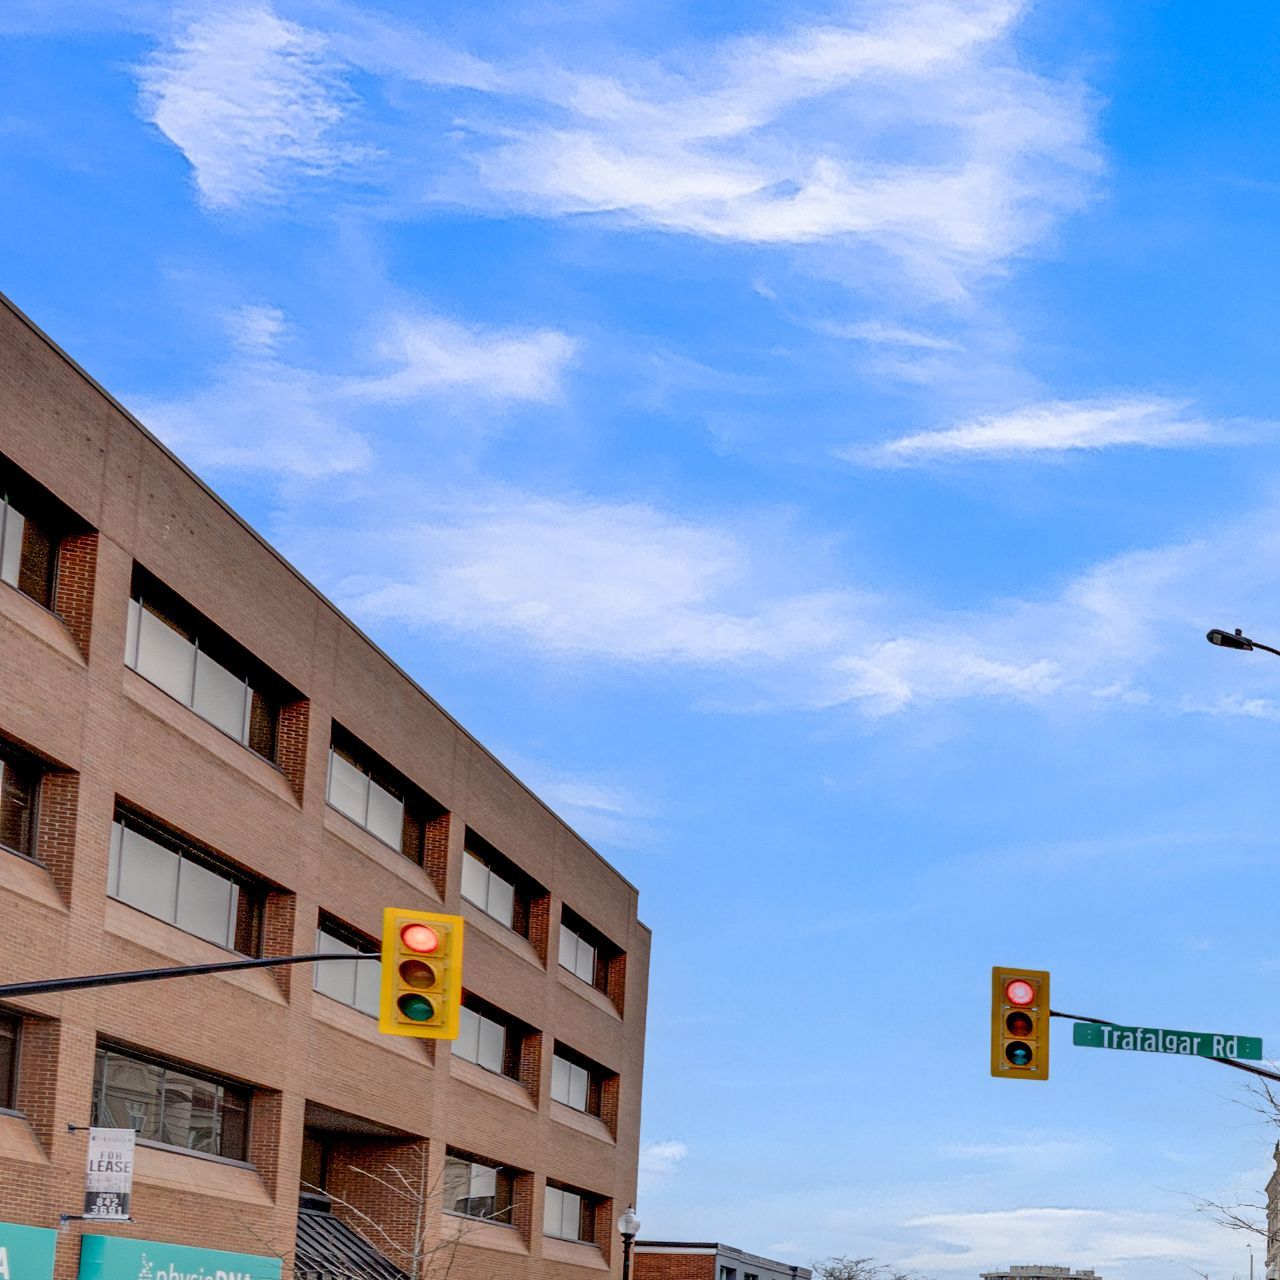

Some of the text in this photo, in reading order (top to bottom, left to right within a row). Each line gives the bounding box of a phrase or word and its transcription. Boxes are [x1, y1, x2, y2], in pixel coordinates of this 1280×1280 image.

[1101, 1026, 1238, 1058] Trafalgar Rd
[100, 1151, 122, 1160] FOR
[89, 1160, 131, 1173] LEASE
[95, 1198, 119, 1207] 842
[90, 1206, 122, 1215] 3691
